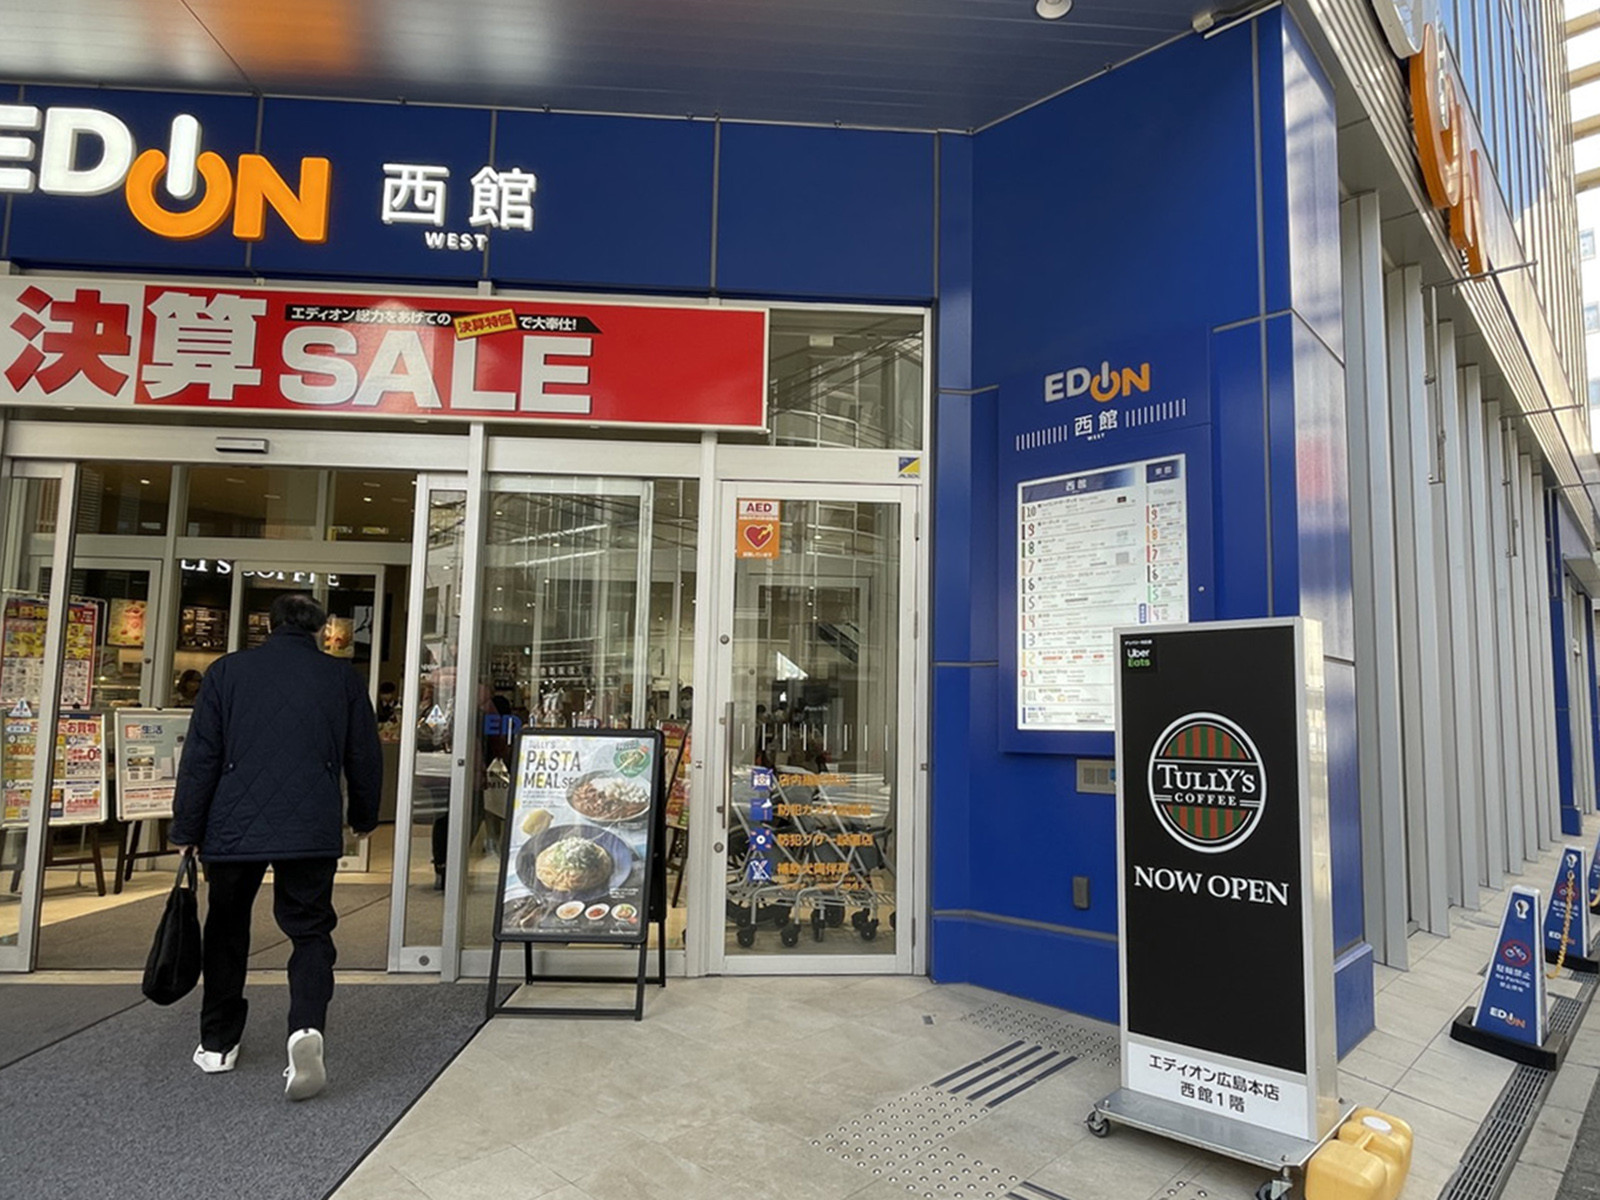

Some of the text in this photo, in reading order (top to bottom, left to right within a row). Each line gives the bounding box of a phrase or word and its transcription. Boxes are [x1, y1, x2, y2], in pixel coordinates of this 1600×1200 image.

[381, 161, 536, 232] 西館
[424, 230, 490, 251] WEST
[290, 306, 451, 326] エディオン総力をあげての
[457, 313, 514, 334] 決算特価
[3, 284, 595, 415] 決算 SALE
[1044, 360, 1151, 403] EDION
[1073, 409, 1119, 437] 西館
[746, 502, 773, 513] AED
[1126, 648, 1151, 658] Uber
[525, 750, 582, 772] PASTA
[1174, 792, 1238, 807] COFFEE
[1133, 865, 1290, 907] NOW OPEN
[1489, 1006, 1527, 1030] EDION
[1148, 1053, 1281, 1102] エディオン広島本店
[1179, 1080, 1246, 1114] 西館1階
